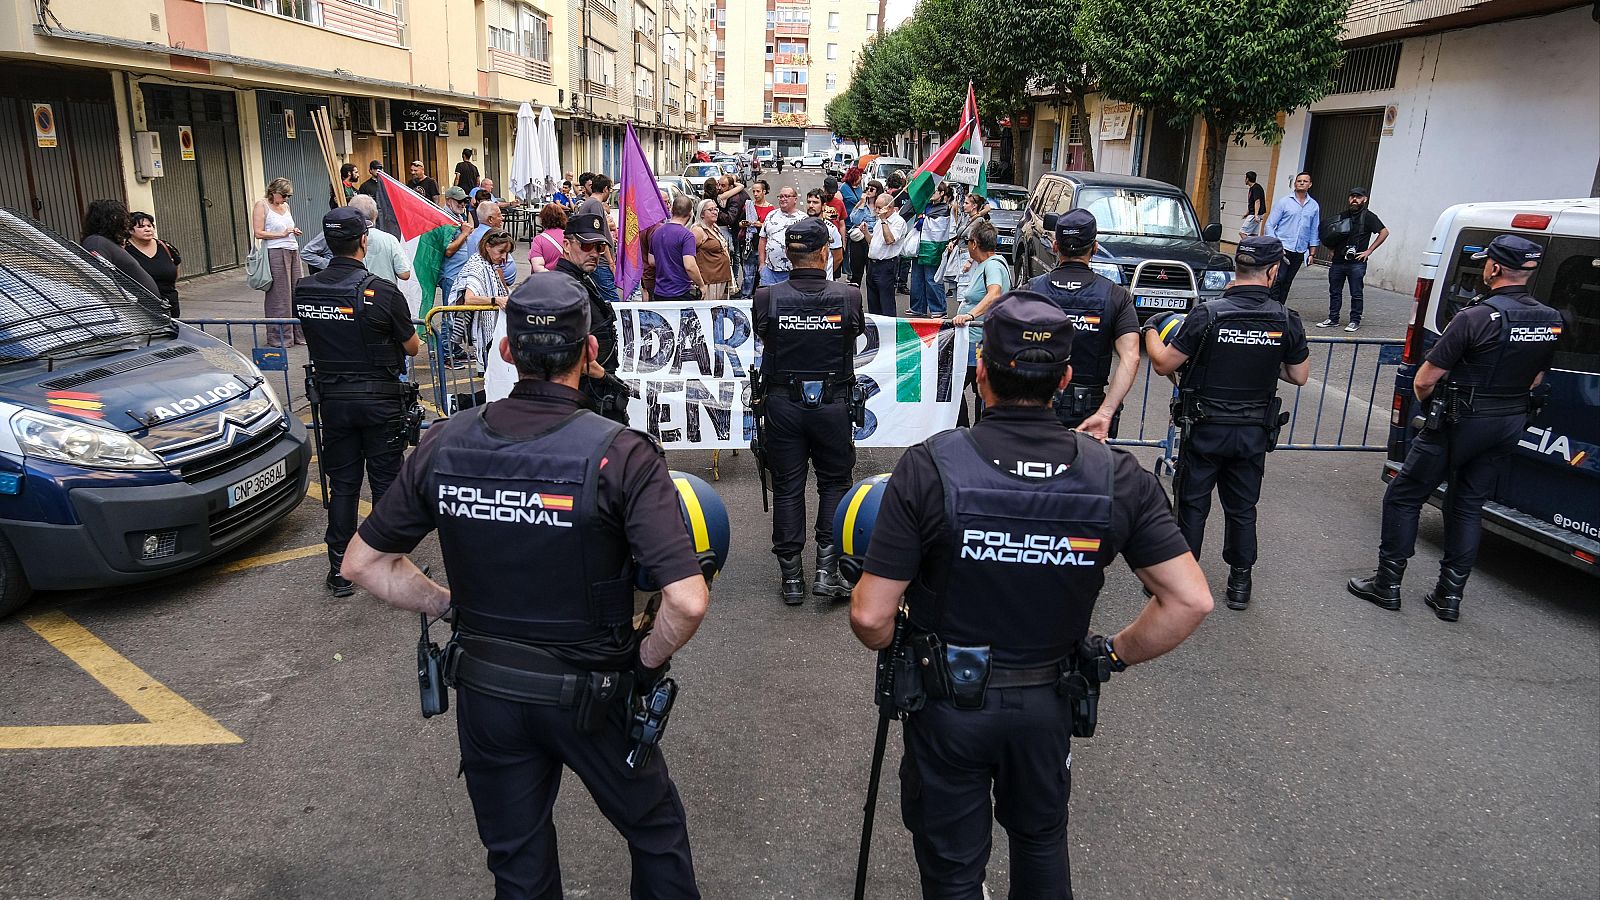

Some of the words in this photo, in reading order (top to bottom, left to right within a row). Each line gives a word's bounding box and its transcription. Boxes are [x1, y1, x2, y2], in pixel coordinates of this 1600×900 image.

[297, 304, 342, 314] POLICIA
[298, 311, 355, 321] NACIONAL
[526, 314, 557, 326] CNP
[778, 315, 830, 323] POLICIA
[778, 322, 842, 331] NACIONAL
[1510, 326, 1553, 335] POLICIA
[1022, 330, 1052, 342] CNP
[1218, 328, 1270, 339] POLICIA
[1217, 335, 1281, 346] NACIONAL
[234, 480, 253, 502] CNP
[254, 468, 275, 492] 3668
[275, 463, 285, 481] AL
[438, 484, 545, 509] POLICIA
[438, 500, 573, 528] NACIONAL
[963, 529, 1073, 552] POLICIA
[960, 545, 1096, 566] NACIONAL
